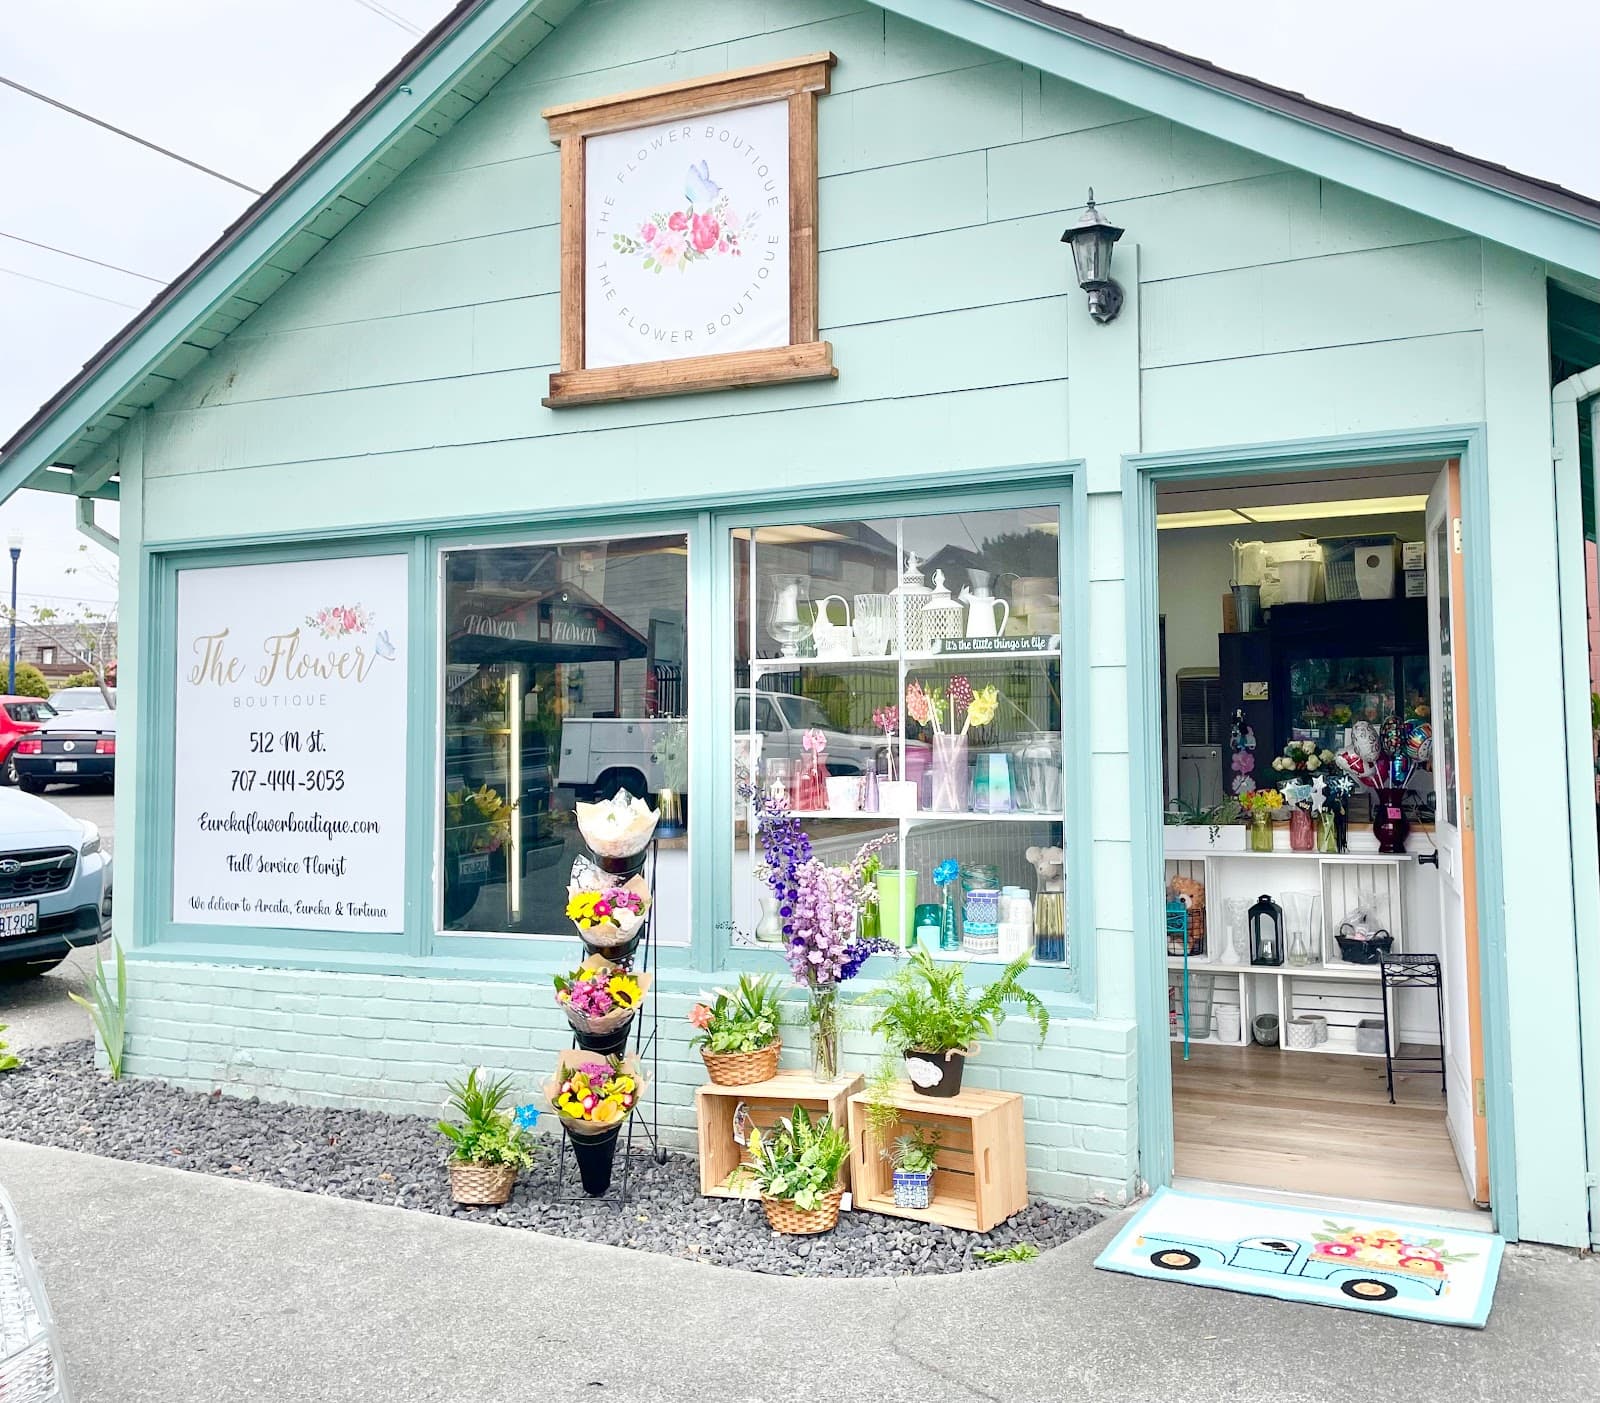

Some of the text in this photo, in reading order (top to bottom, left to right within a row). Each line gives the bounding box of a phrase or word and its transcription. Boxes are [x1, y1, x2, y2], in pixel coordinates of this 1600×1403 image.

[596, 126, 779, 237] THE FLOWER BOUTIQUE
[597, 234, 779, 343] THE FLOWER BOUTIQUE
[552, 621, 597, 644] Flowers
[959, 639, 972, 650] the
[972, 638, 993, 650] little
[993, 638, 1020, 651] things
[1021, 638, 1030, 649] in
[1031, 637, 1046, 650] life
[187, 627, 377, 687] The Flower
[233, 693, 328, 708] BOUTIQUE
[250, 729, 327, 753] 512 M St.
[231, 769, 345, 792] 707-444-3053
[198, 810, 380, 841] Eurekaflowerboutique.com
[226, 853, 348, 877] Full Service Florist
[188, 895, 389, 918] We deliver to Arcata, Eureka & Fortuna
